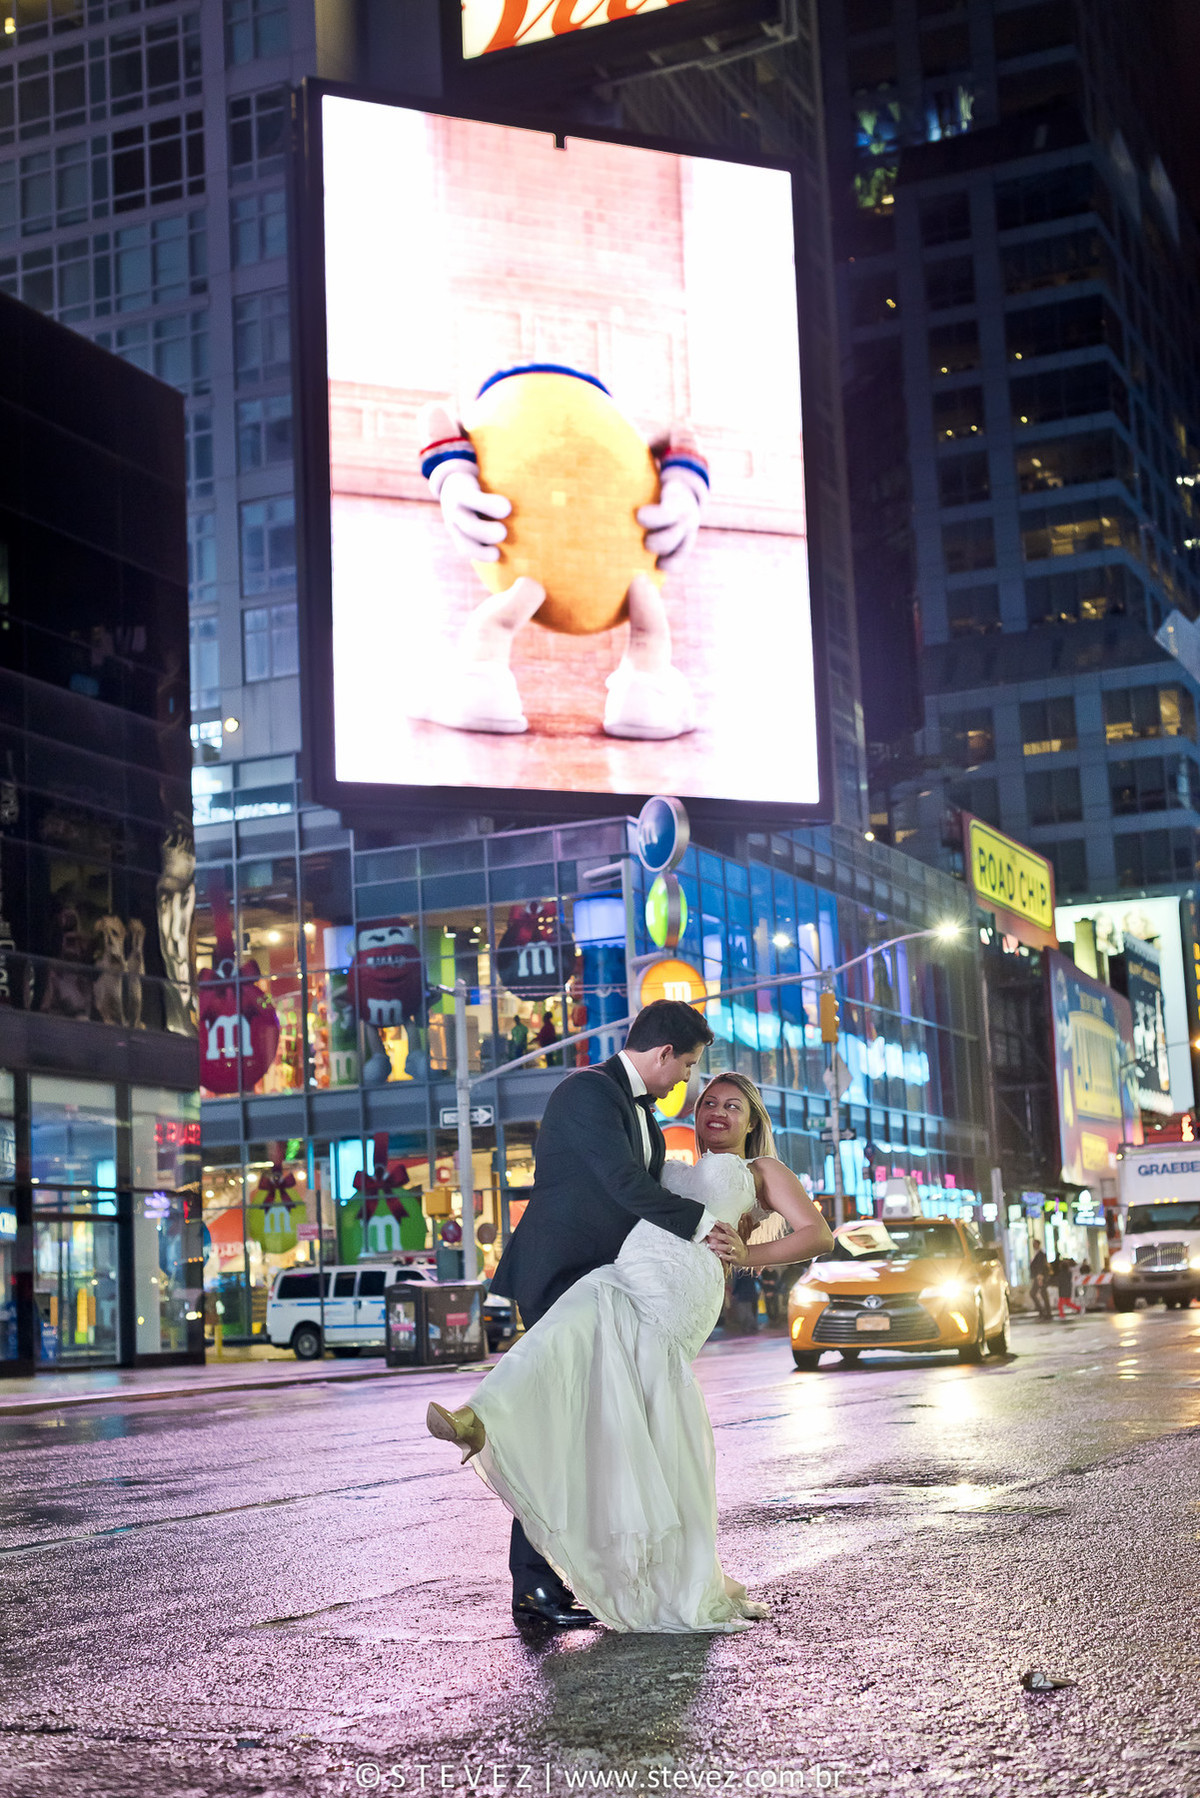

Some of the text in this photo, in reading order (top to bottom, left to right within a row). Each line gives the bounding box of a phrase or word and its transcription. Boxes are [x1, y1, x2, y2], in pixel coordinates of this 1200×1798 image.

[978, 846, 1048, 918] ROAD CHIP
[517, 940, 556, 977] m
[366, 997, 403, 1028] m
[204, 1014, 254, 1061] m
[263, 1205, 293, 1234] m
